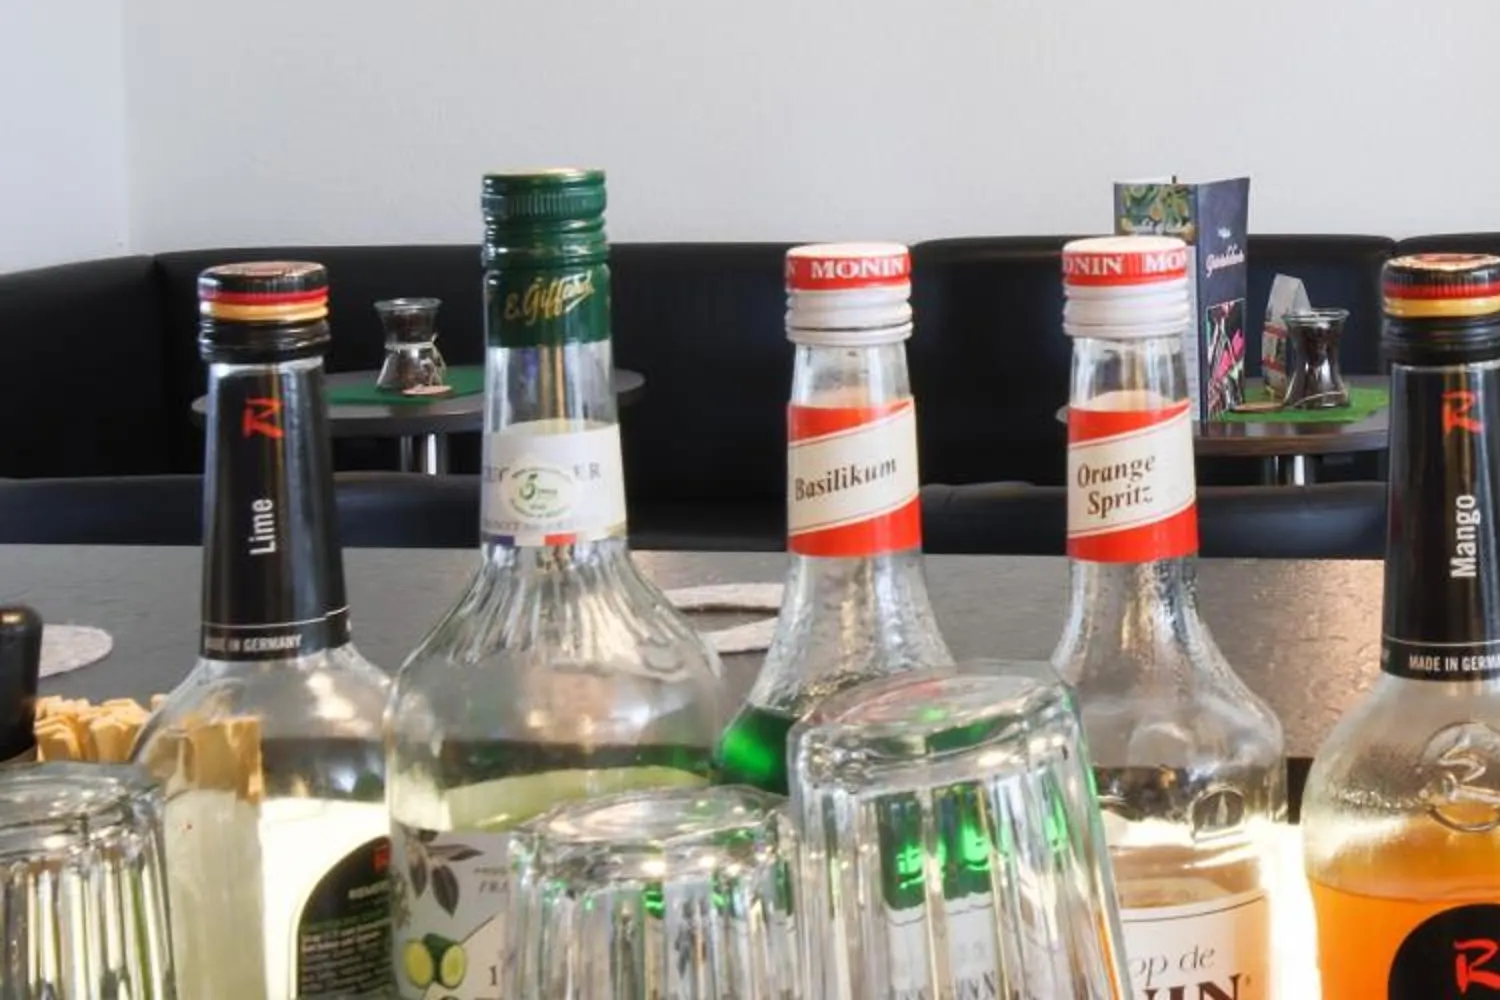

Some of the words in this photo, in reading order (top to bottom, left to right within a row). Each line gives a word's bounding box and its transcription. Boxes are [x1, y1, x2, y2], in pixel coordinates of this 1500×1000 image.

[810, 256, 907, 280] MONIN
[1062, 252, 1123, 276] ONIN
[794, 459, 897, 502] Basilikum
[1077, 455, 1156, 489] Orange
[1087, 484, 1153, 519] Spritz
[248, 498, 277, 556] Lime
[1450, 494, 1481, 578] Mango
[1409, 654, 1441, 672] MADE
[1445, 654, 1459, 672] IN
[1179, 944, 1216, 970] de
